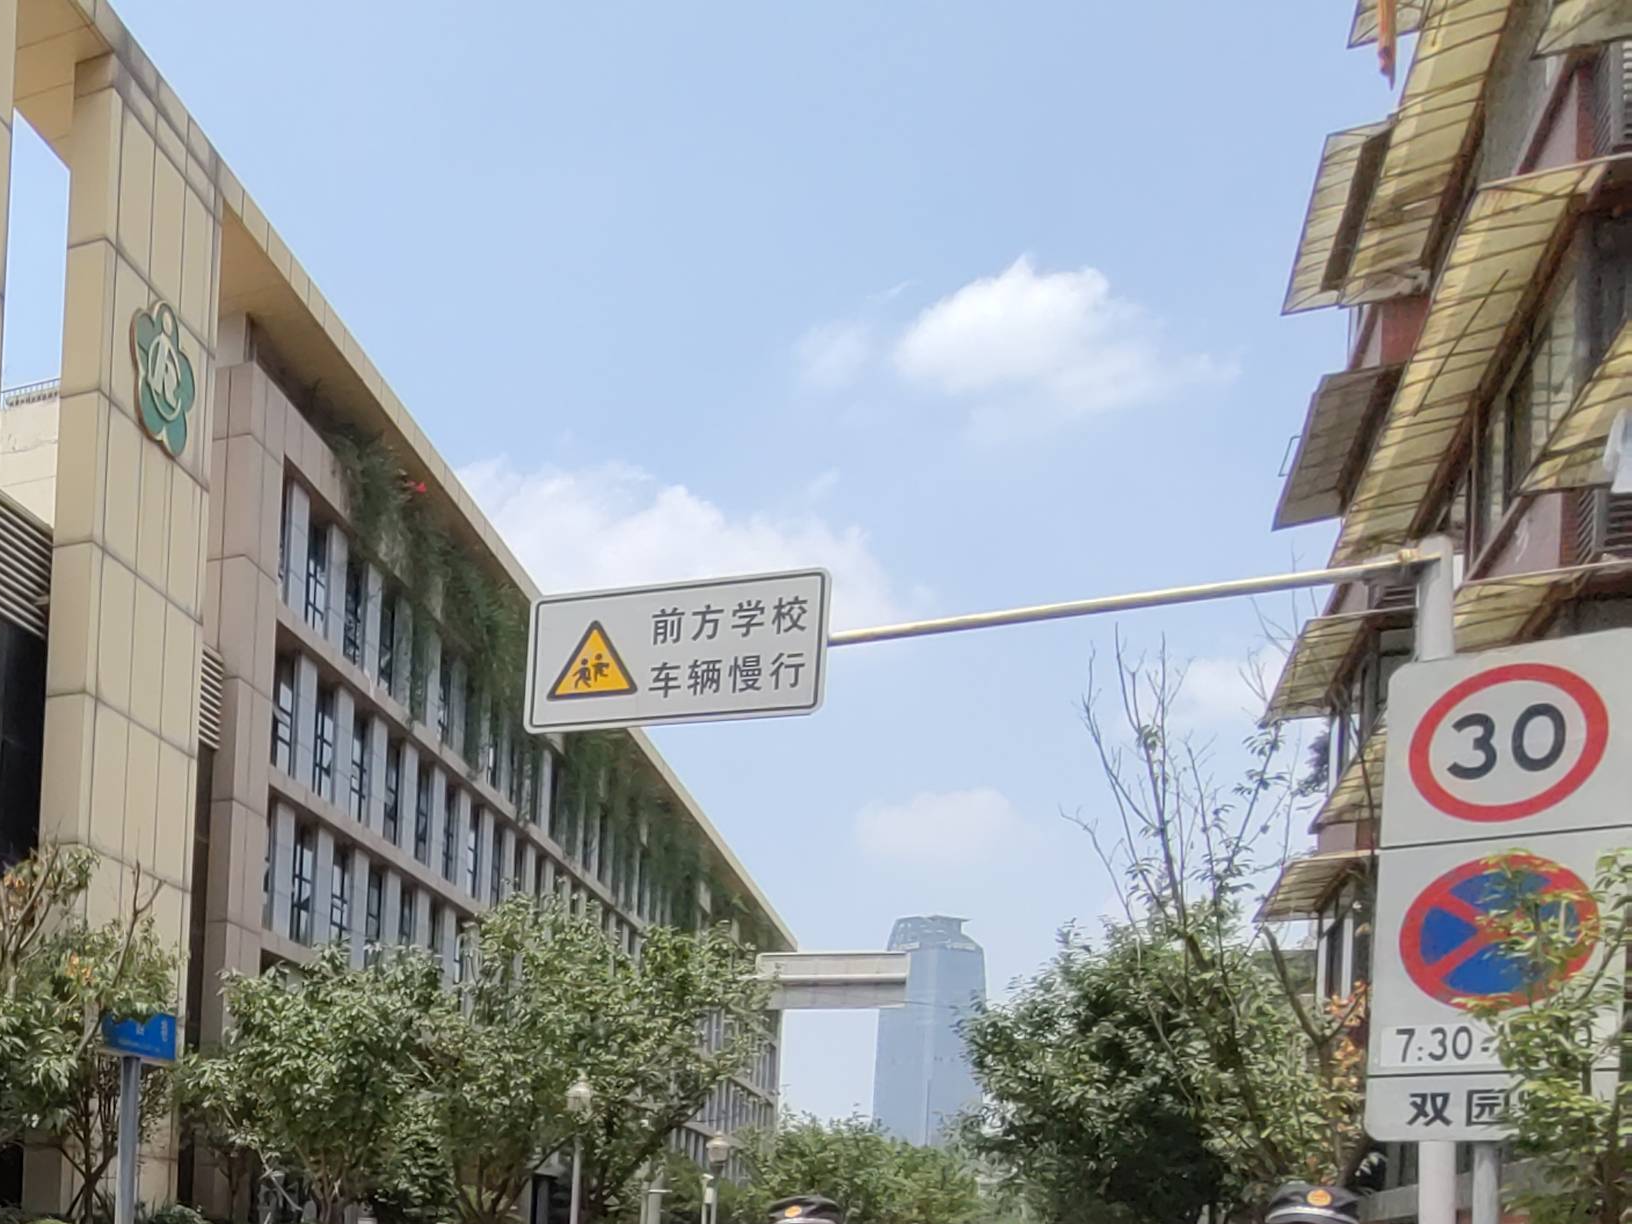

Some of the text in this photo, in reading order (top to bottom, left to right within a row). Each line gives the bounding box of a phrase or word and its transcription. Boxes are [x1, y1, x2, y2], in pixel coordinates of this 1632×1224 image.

[651, 595, 809, 646] 前方学校
[647, 652, 806, 699] 车辆慢行
[1446, 702, 1568, 781] 30
